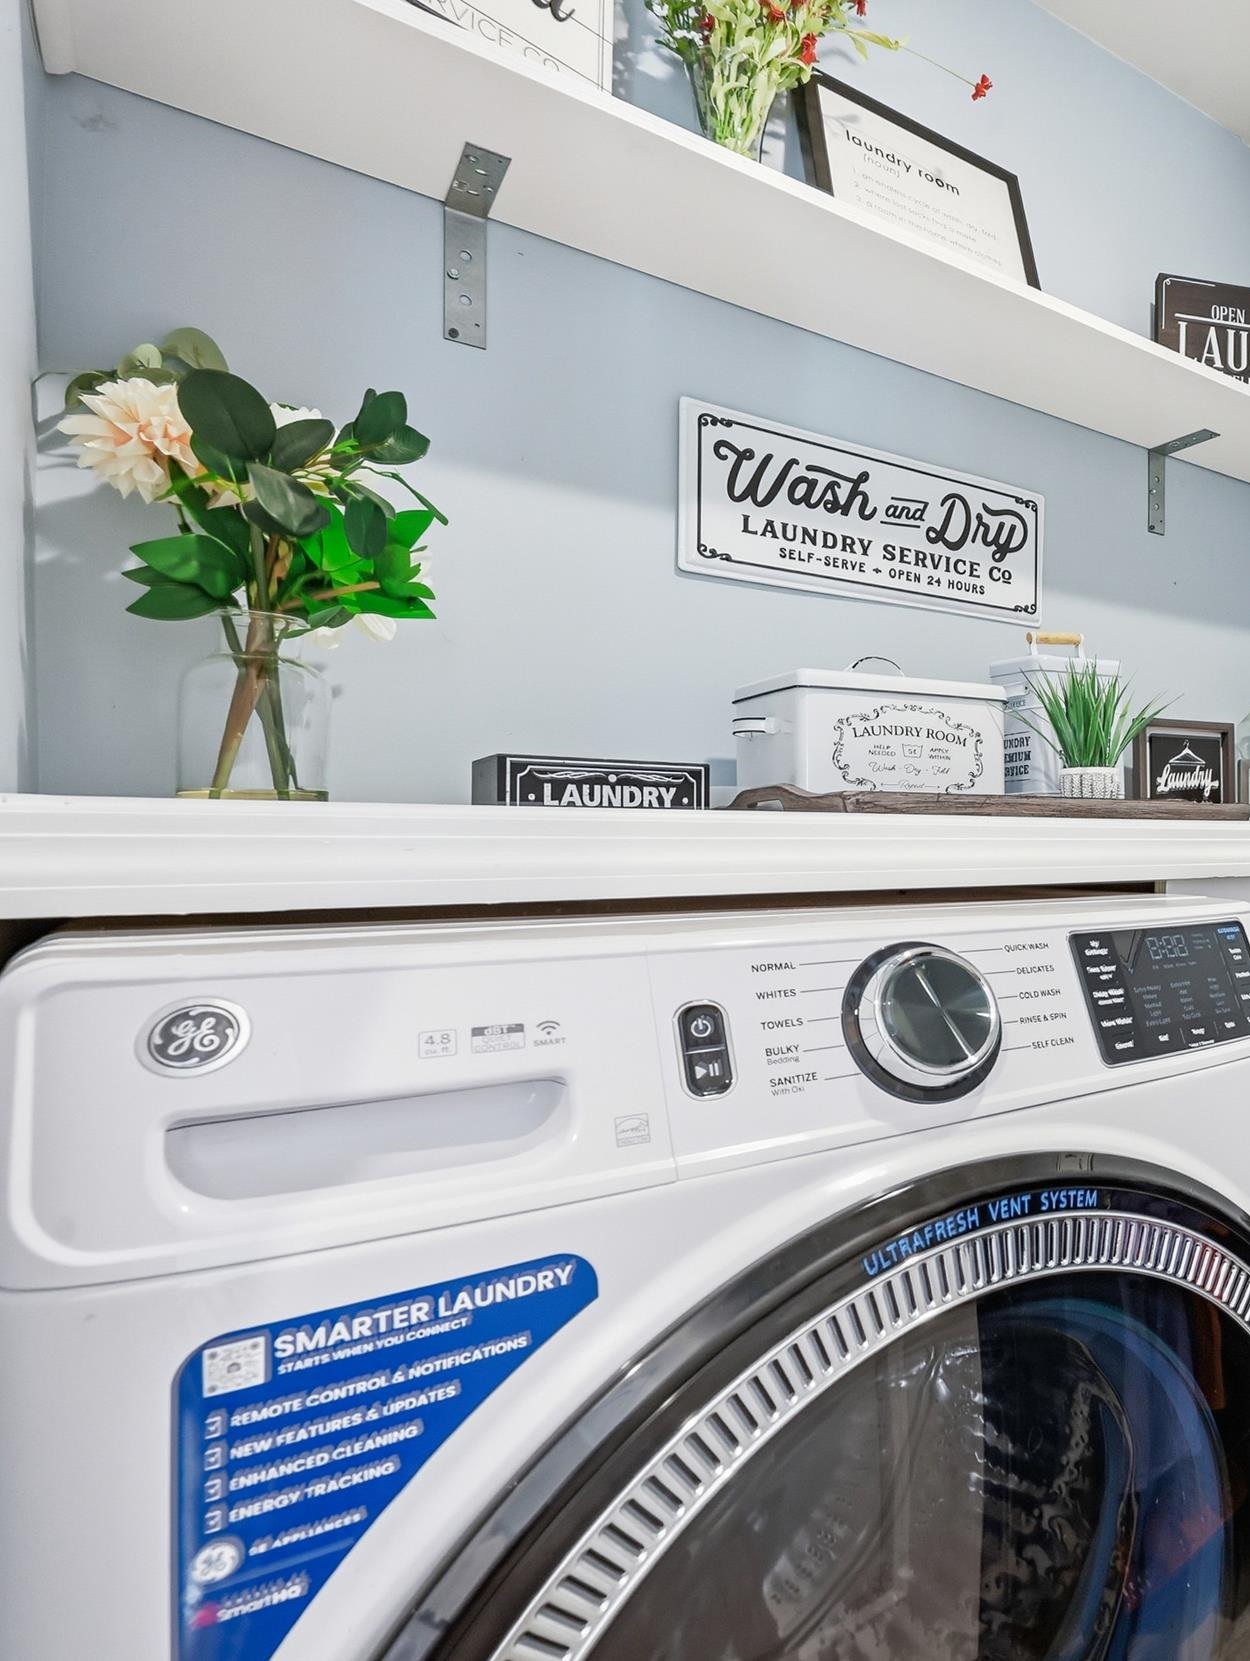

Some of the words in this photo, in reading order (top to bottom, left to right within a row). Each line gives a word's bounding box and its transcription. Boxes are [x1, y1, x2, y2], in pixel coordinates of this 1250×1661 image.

[845, 129, 912, 173] laundry
[918, 168, 960, 196] room
[1212, 304, 1245, 325] OPEN
[712, 439, 878, 522] Wash
[884, 497, 929, 524] and
[926, 492, 1029, 563] Dry
[741, 514, 873, 557] LAUNDRY
[882, 543, 981, 579] SERVICE
[778, 547, 866, 574] SELF-SERVE
[888, 567, 922, 584] OPEN
[927, 575, 943, 588] 24
[947, 578, 986, 596] HOURS
[852, 725, 923, 739] LAUNDRY
[926, 728, 967, 747] ROOM
[1004, 736, 1031, 749] UNDRY
[868, 749, 896, 757] NEEDED
[1004, 751, 1031, 764] EMIUM
[1005, 764, 1029, 777] RVICE
[1156, 764, 1219, 797] Laundry
[543, 783, 677, 808] LAUNDRY
[1004, 943, 1027, 953] QUICK
[1028, 943, 1049, 951] WASH
[751, 961, 796, 973] NORMAL
[1016, 964, 1055, 975] DELICATES
[755, 988, 797, 1000] WHITES
[1019, 991, 1039, 1000] COLD
[1040, 988, 1061, 997] WASH
[760, 1017, 804, 1030] TOWELS
[1020, 1014, 1041, 1024] RINSE
[1050, 1012, 1067, 1020] SPIN
[424, 1033, 451, 1045] 4.8
[533, 1037, 567, 1047] SMART
[1032, 1040, 1049, 1050] SELF
[1050, 1036, 1074, 1047] CLEAN
[765, 1044, 800, 1057] BULKY
[766, 1055, 801, 1066] Bedding
[769, 1072, 818, 1088] SANITIZE
[771, 1086, 790, 1096] With
[862, 1205, 981, 1278] ULTRAFRESH
[988, 1193, 1032, 1221] VENT
[1040, 1189, 1098, 1212] SYSTEM
[274, 1301, 430, 1359] SMARTER
[438, 1264, 573, 1317] LAUNDRY
[277, 1351, 330, 1375] STARTS
[332, 1342, 374, 1364] WHEN
[374, 1333, 405, 1352] YOU
[406, 1316, 468, 1342] CONNECT
[230, 1398, 303, 1428] REMOTE
[305, 1375, 390, 1406] CONTROL
[391, 1370, 406, 1383] &
[408, 1335, 528, 1381] NOTIFICATIONS
[230, 1439, 272, 1460] NEW
[276, 1412, 363, 1444] FEATURES
[365, 1407, 379, 1421] &
[382, 1384, 457, 1416] UPDATES
[229, 1452, 329, 1491] ENHANCED
[332, 1423, 419, 1460] CLEANING
[228, 1491, 300, 1522] ENERGY
[304, 1460, 396, 1500] TRACKING
[271, 1513, 362, 1549] APPLIANCES
[216, 1583, 301, 1623] SmartHQ
